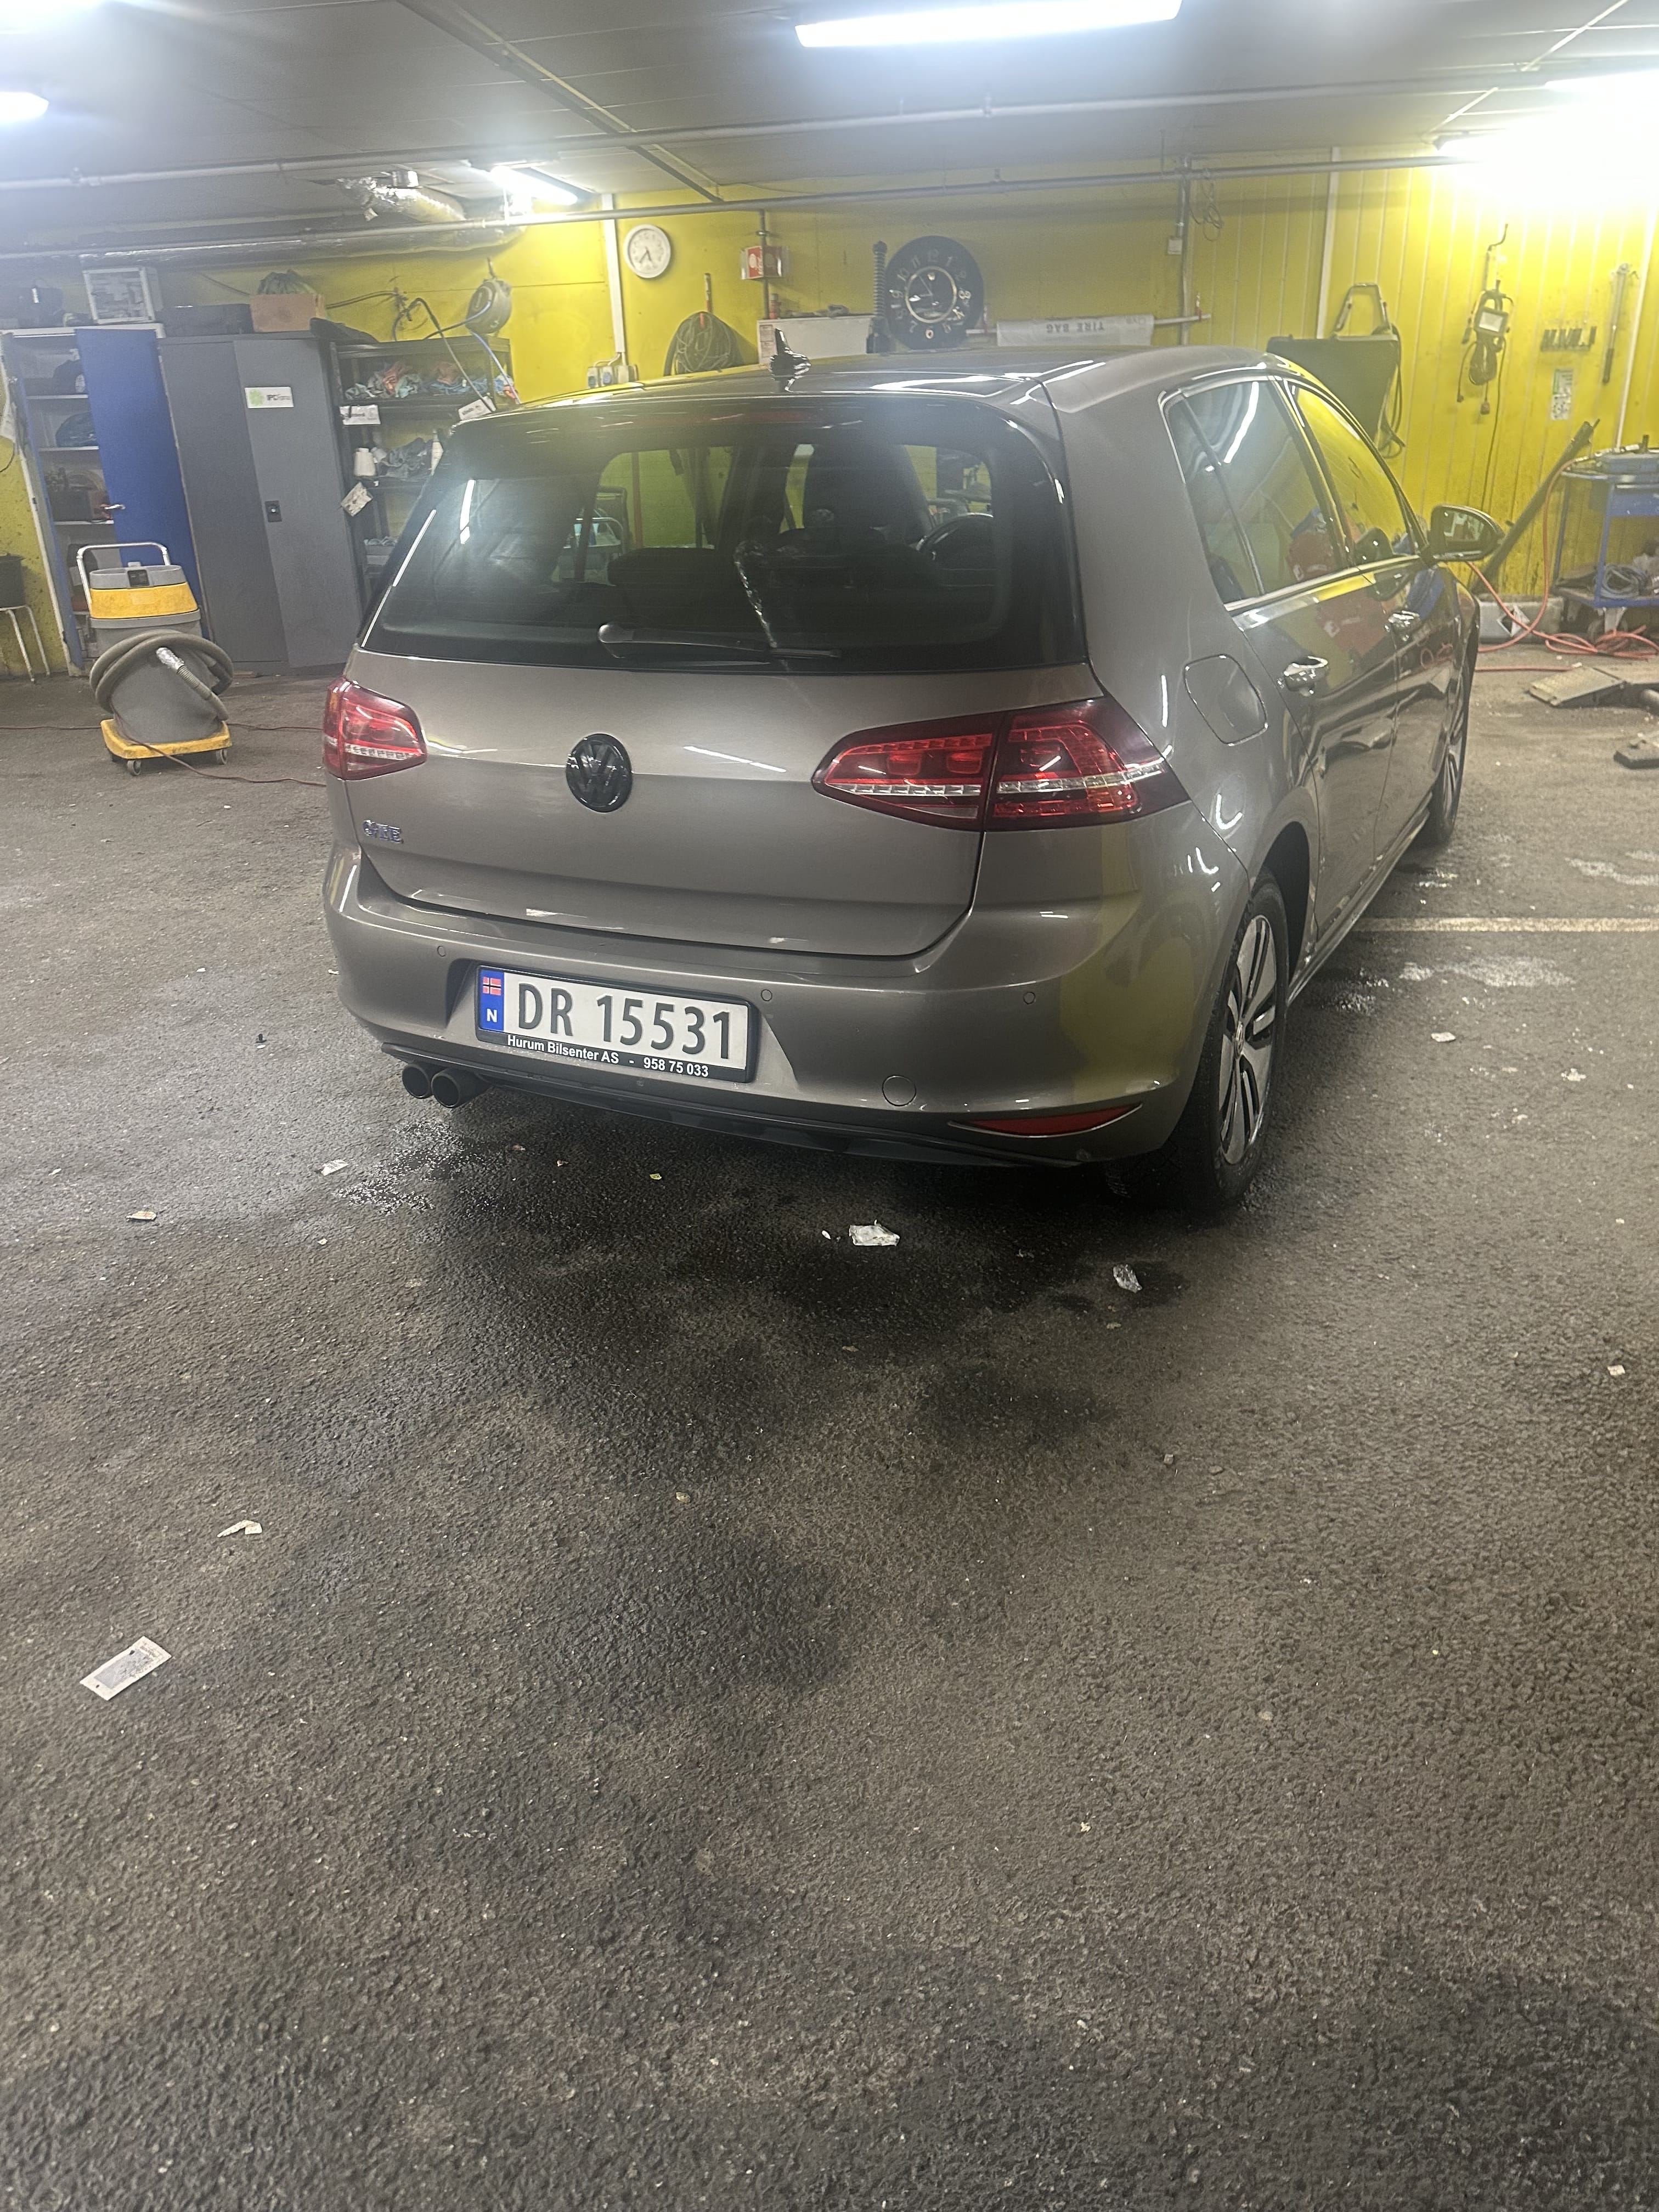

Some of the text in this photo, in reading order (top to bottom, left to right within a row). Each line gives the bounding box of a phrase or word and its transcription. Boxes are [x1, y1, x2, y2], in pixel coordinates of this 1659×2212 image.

[1046, 321, 1104, 334] TIRE BAG
[487, 1008, 498, 1023] N
[518, 983, 730, 1059] DR 15531
[507, 1035, 545, 1052] Hurum
[548, 1042, 599, 1060] Bilsenter
[601, 1051, 619, 1064] AS
[644, 1057, 665, 1070] 958
[669, 1060, 684, 1074] 75
[687, 1064, 709, 1077] 033
